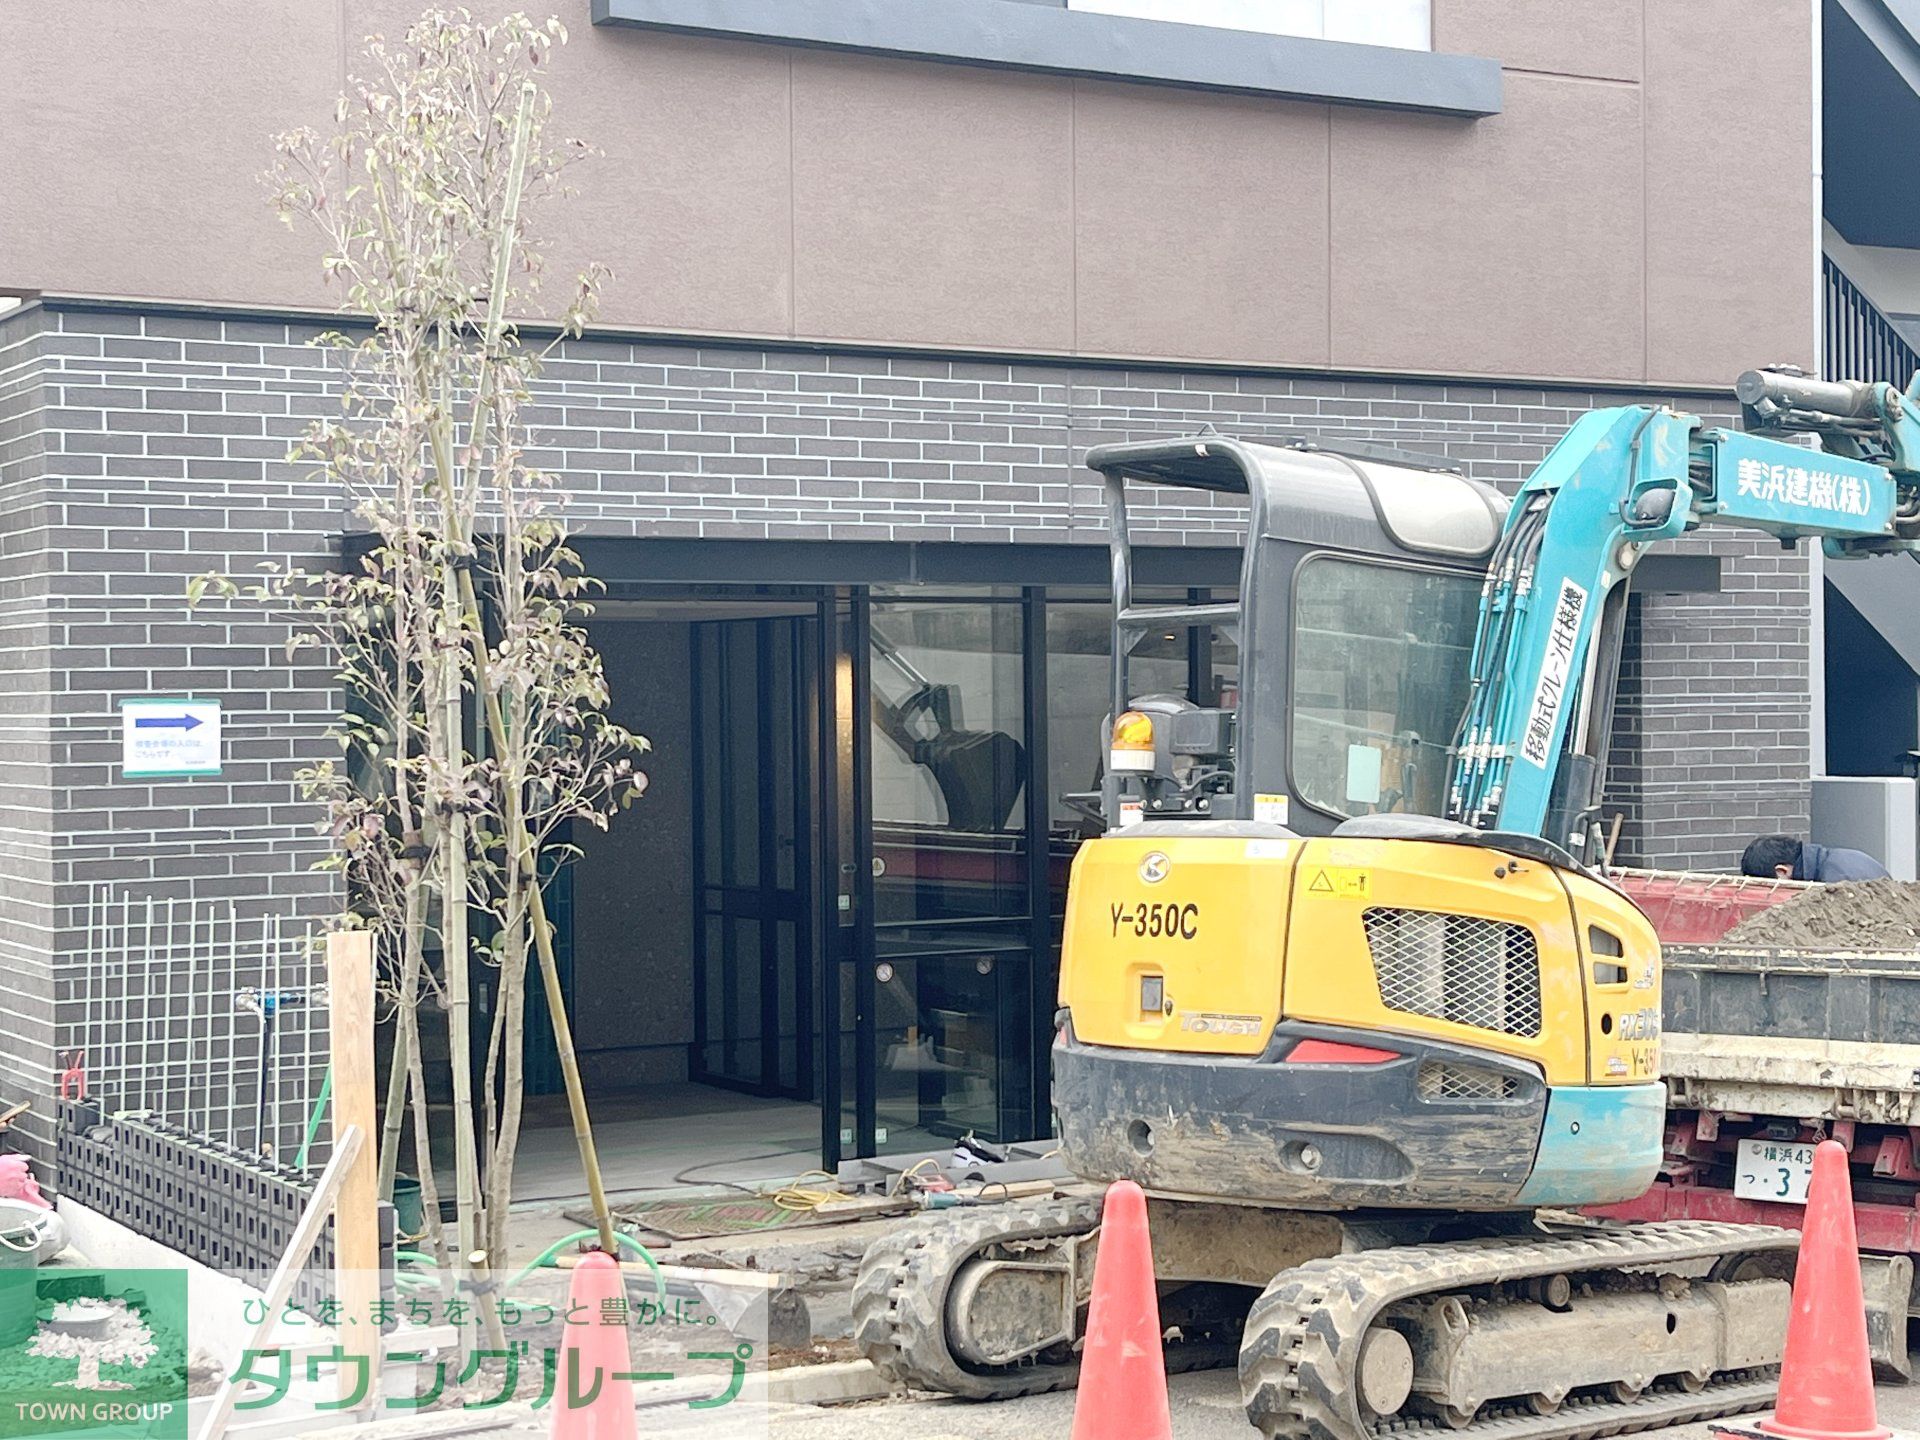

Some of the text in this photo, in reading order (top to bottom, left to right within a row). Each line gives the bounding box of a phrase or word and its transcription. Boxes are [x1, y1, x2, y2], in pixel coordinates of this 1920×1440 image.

[1525, 586, 1582, 762] 移動式クレーン仕様機
[1111, 902, 1199, 940] Y-350C
